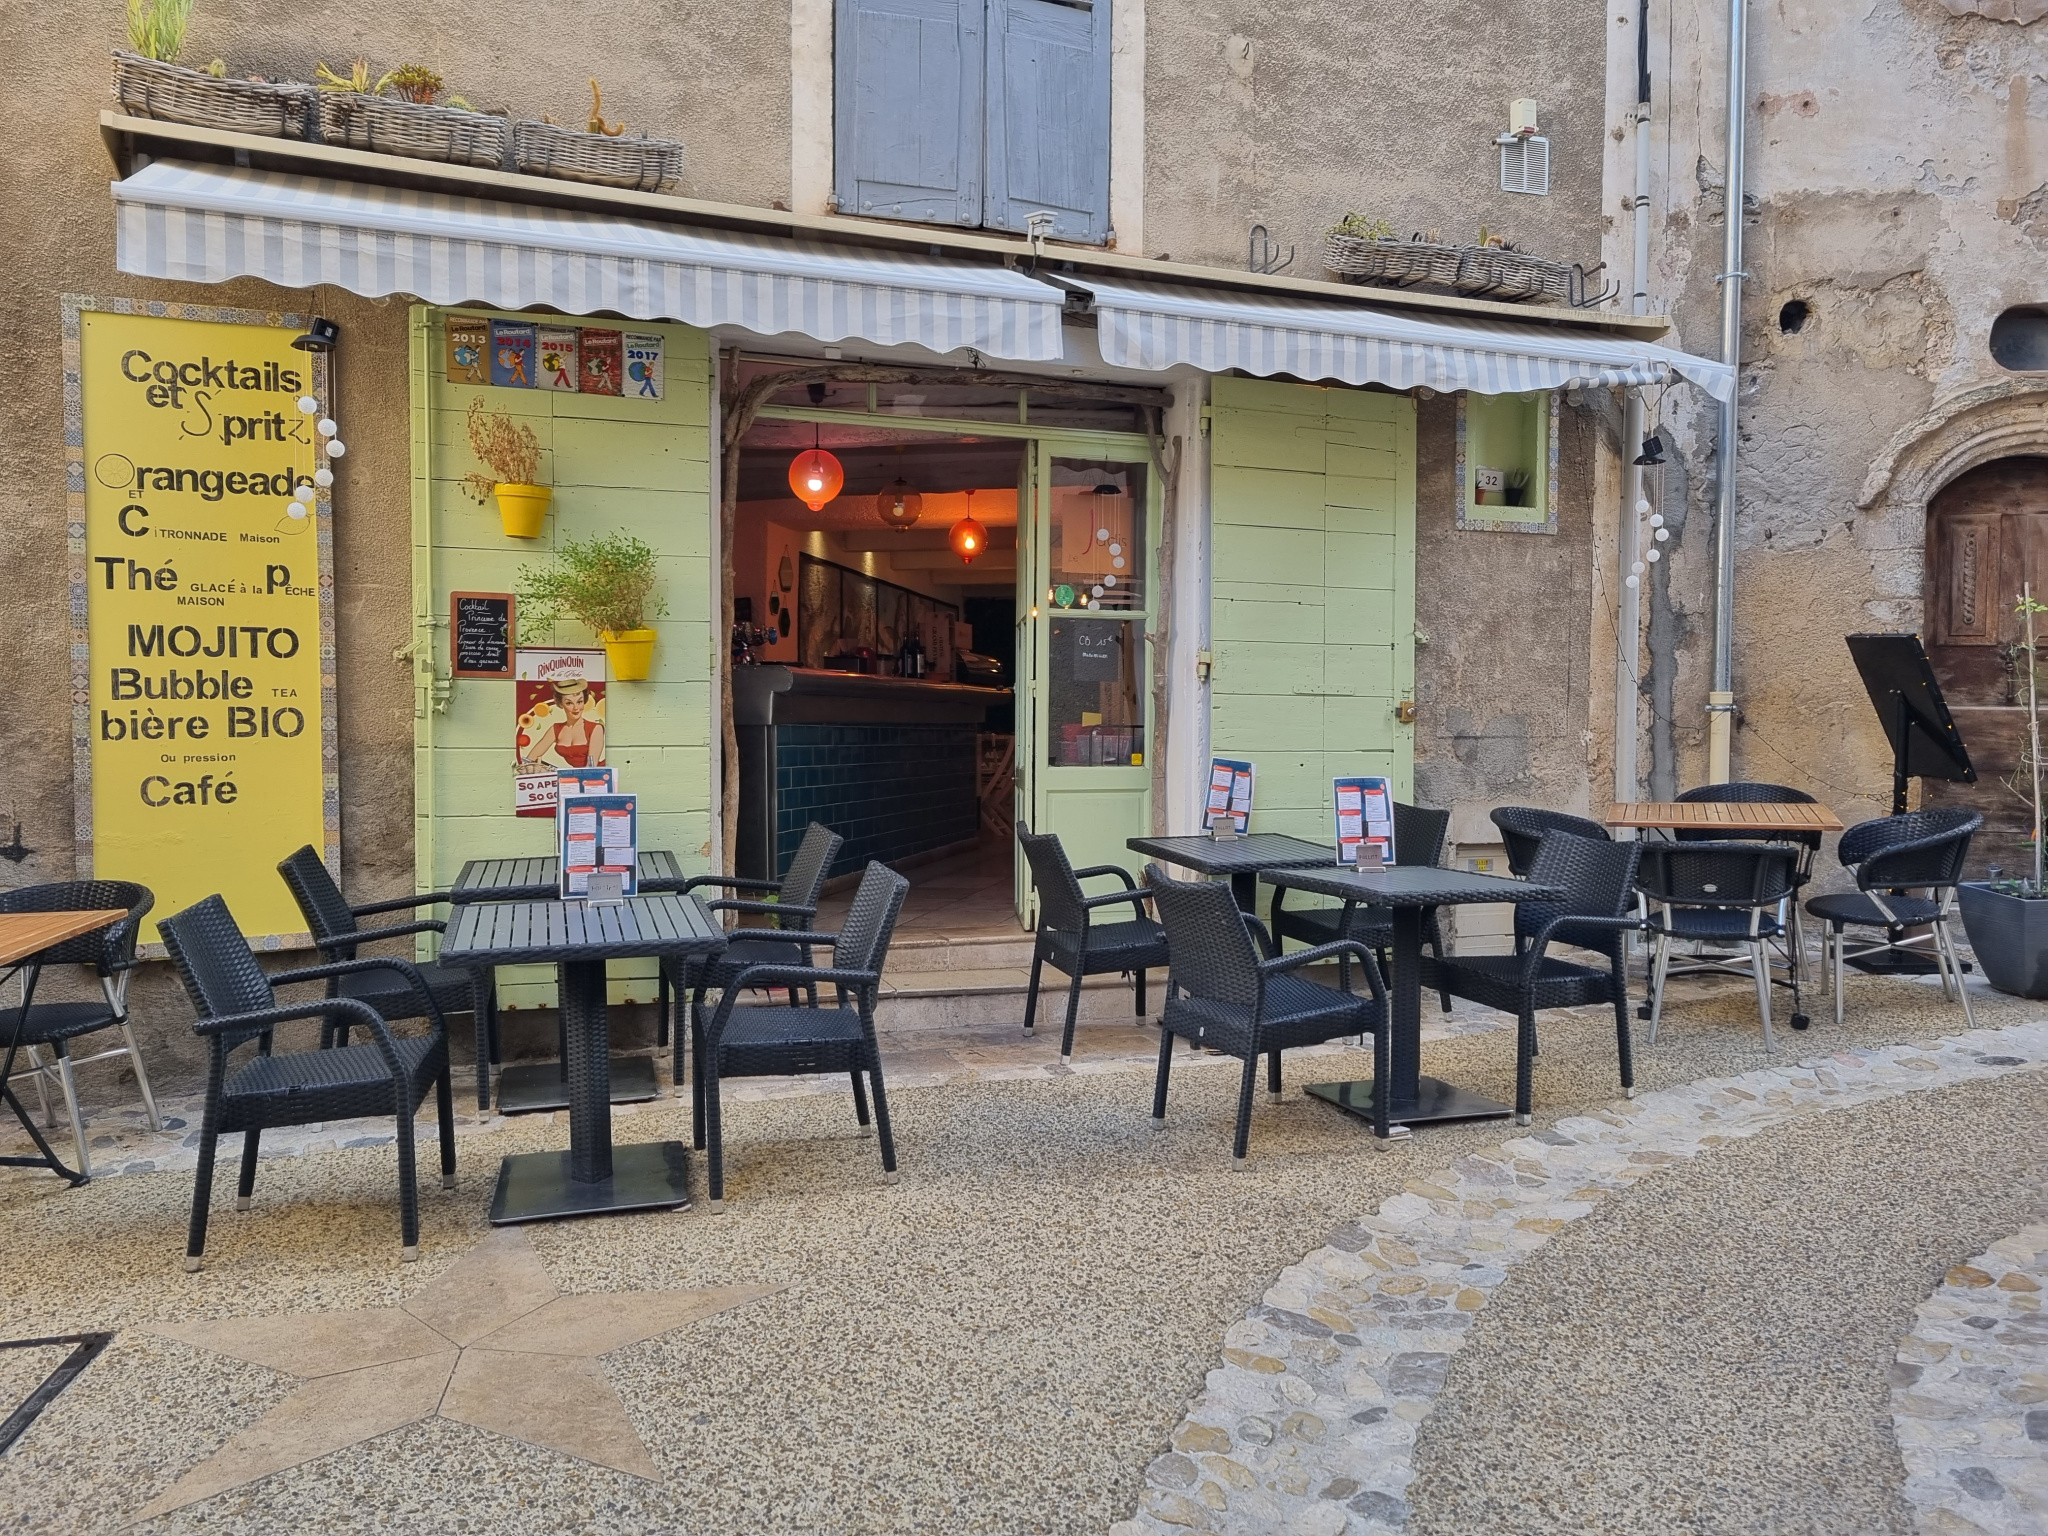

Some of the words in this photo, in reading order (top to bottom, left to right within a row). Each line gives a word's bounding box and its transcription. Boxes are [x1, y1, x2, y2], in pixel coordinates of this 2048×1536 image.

[452, 333, 487, 344] 2013
[496, 336, 531, 348] 2014
[541, 341, 574, 352] 2015
[627, 349, 659, 361] 2017
[120, 350, 302, 393] Cocktails
[146, 383, 184, 410] et
[1485, 475, 1498, 486] 32
[128, 489, 144, 499] ET
[239, 532, 280, 544] Maison
[94, 556, 178, 591] Thé
[190, 578, 236, 594] GLACÉ
[239, 582, 247, 594] à
[252, 585, 263, 595] la
[177, 596, 225, 606] MAISON
[459, 598, 490, 611] Cocktail
[457, 619, 487, 633] Provence
[127, 624, 300, 659] MOJITO
[110, 667, 254, 701] Bubble
[271, 688, 298, 698] TEA
[101, 707, 209, 741] bière
[227, 706, 305, 738] BIO
[160, 753, 177, 763] Ou
[183, 752, 237, 764] pression
[140, 770, 238, 808] Café
[518, 782, 535, 791] SO
[528, 793, 545, 802] SO
